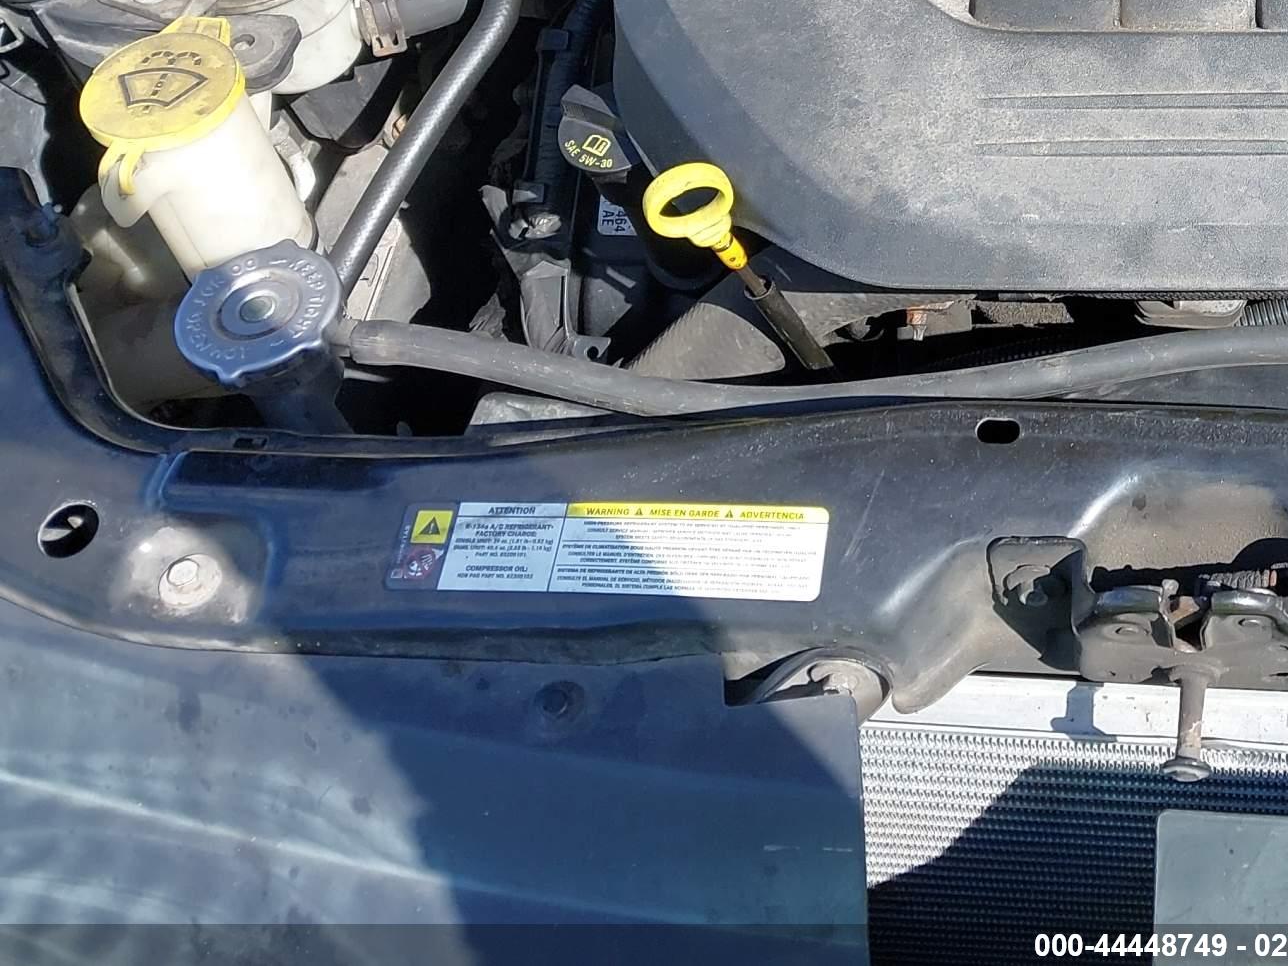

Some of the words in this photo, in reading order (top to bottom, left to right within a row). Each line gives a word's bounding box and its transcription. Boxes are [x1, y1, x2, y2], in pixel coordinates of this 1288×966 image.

[564, 139, 580, 158] SAE
[578, 153, 613, 169] 5W-30
[489, 507, 536, 515] ATTENTION
[688, 510, 720, 518] GARDE
[740, 511, 804, 520] ADVERTENCIA
